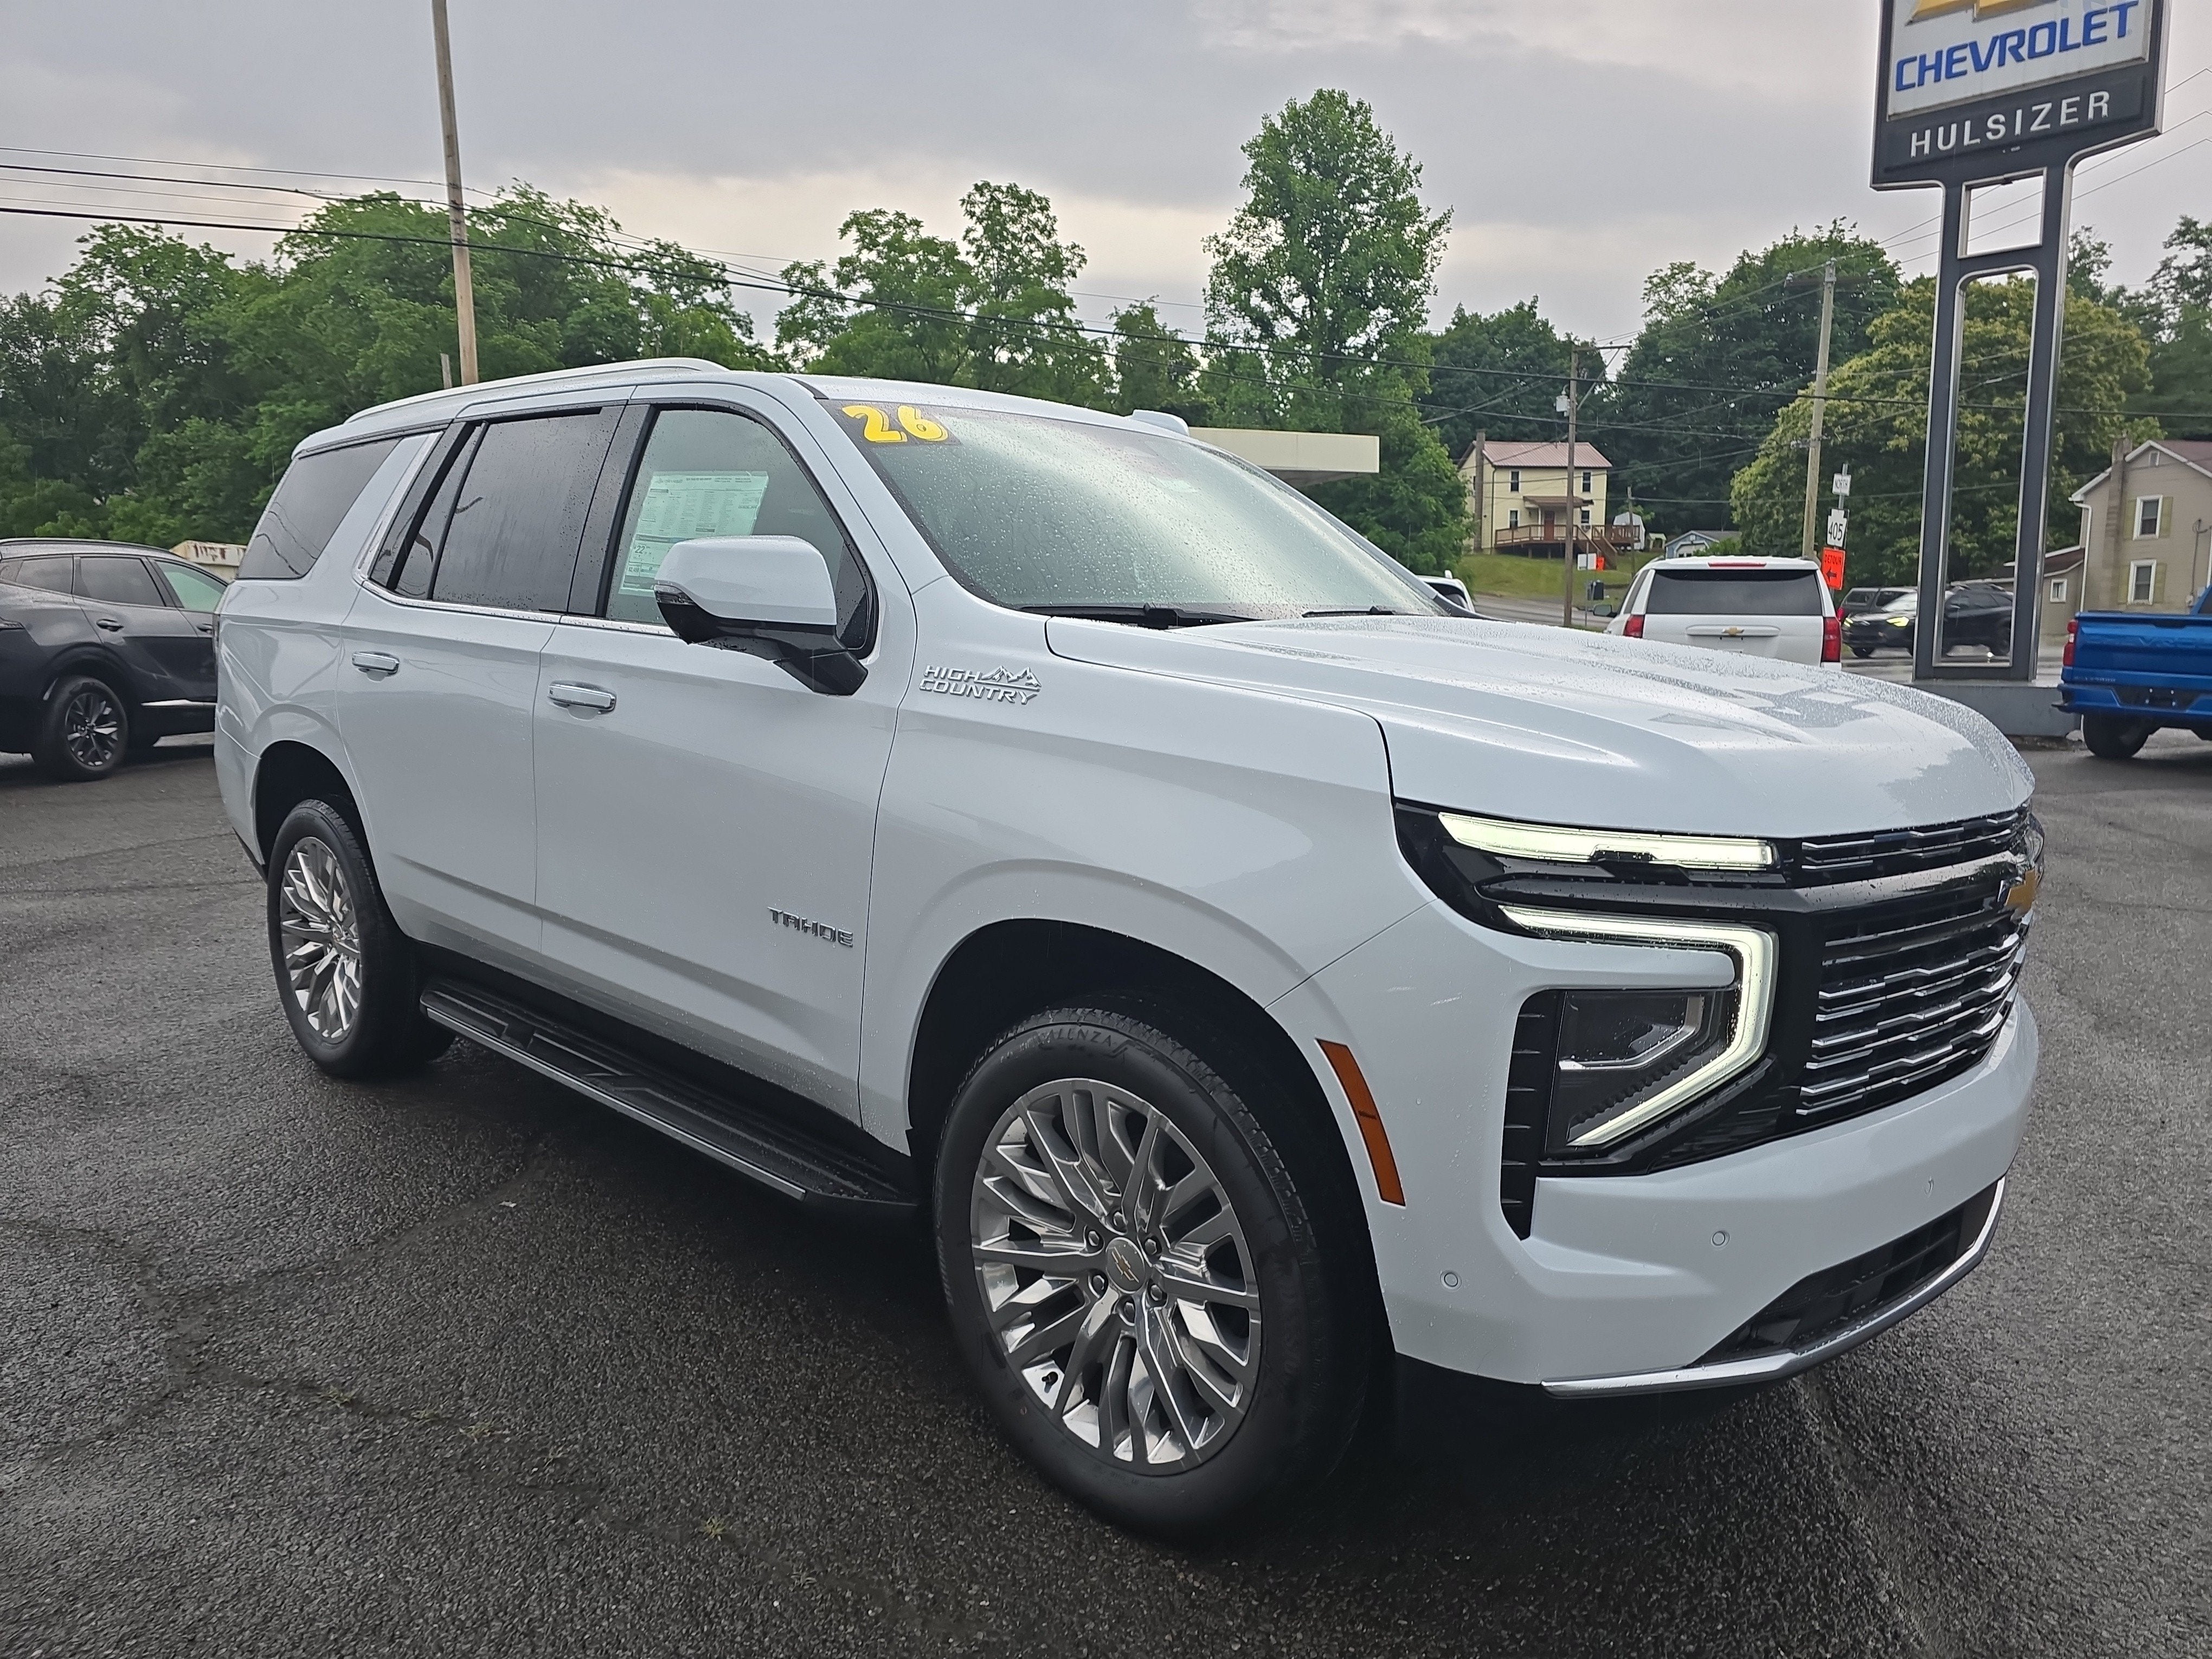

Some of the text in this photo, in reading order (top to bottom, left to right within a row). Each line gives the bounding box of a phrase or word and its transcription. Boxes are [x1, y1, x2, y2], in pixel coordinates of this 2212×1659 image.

[1895, 1, 2139, 92] CHEVROLET
[1909, 91, 2110, 158] HULSIZER
[841, 404, 948, 443] 26
[1835, 478, 1849, 490] NORTH
[1829, 522, 1843, 541] 405
[635, 545, 645, 554] 22
[1824, 554, 1842, 565] DETOUR
[923, 665, 982, 682] HIGH
[919, 678, 1038, 705] COUNTRY
[767, 906, 853, 948] TAHOE
